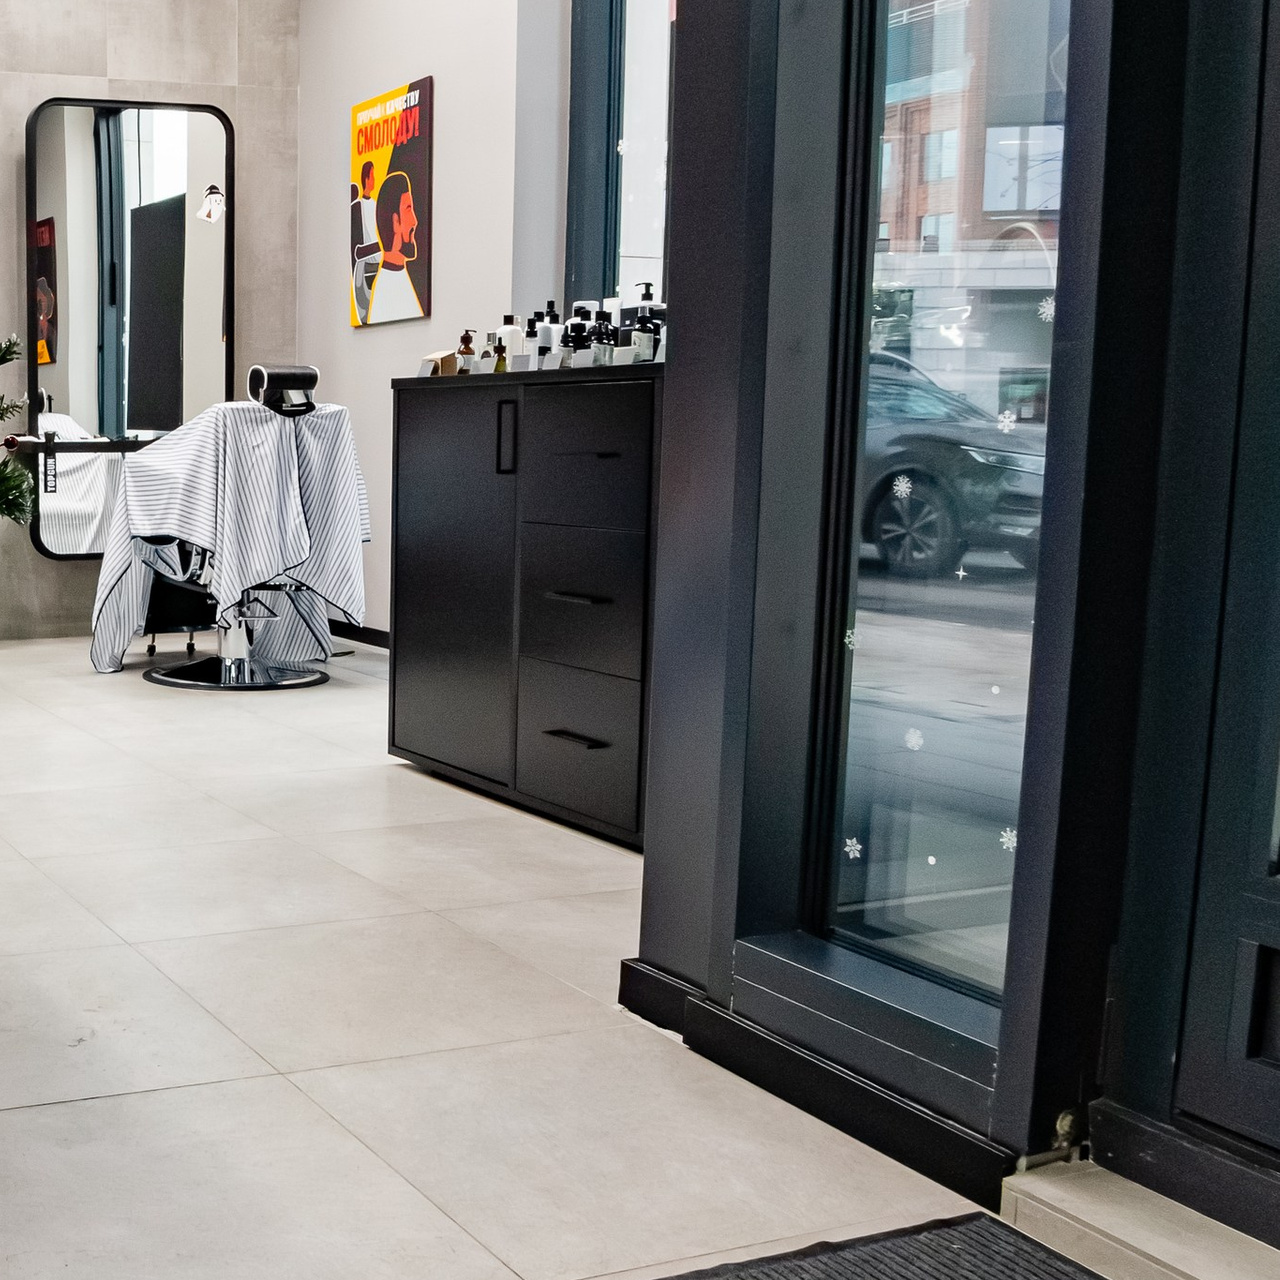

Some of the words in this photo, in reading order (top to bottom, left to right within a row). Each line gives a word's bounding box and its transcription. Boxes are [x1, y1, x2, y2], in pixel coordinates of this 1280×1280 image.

[386, 89, 420, 116] КАЧЕСТВУ
[357, 106, 420, 156] СМОЛОДУ!
[46, 458, 56, 492] TOPGUN
